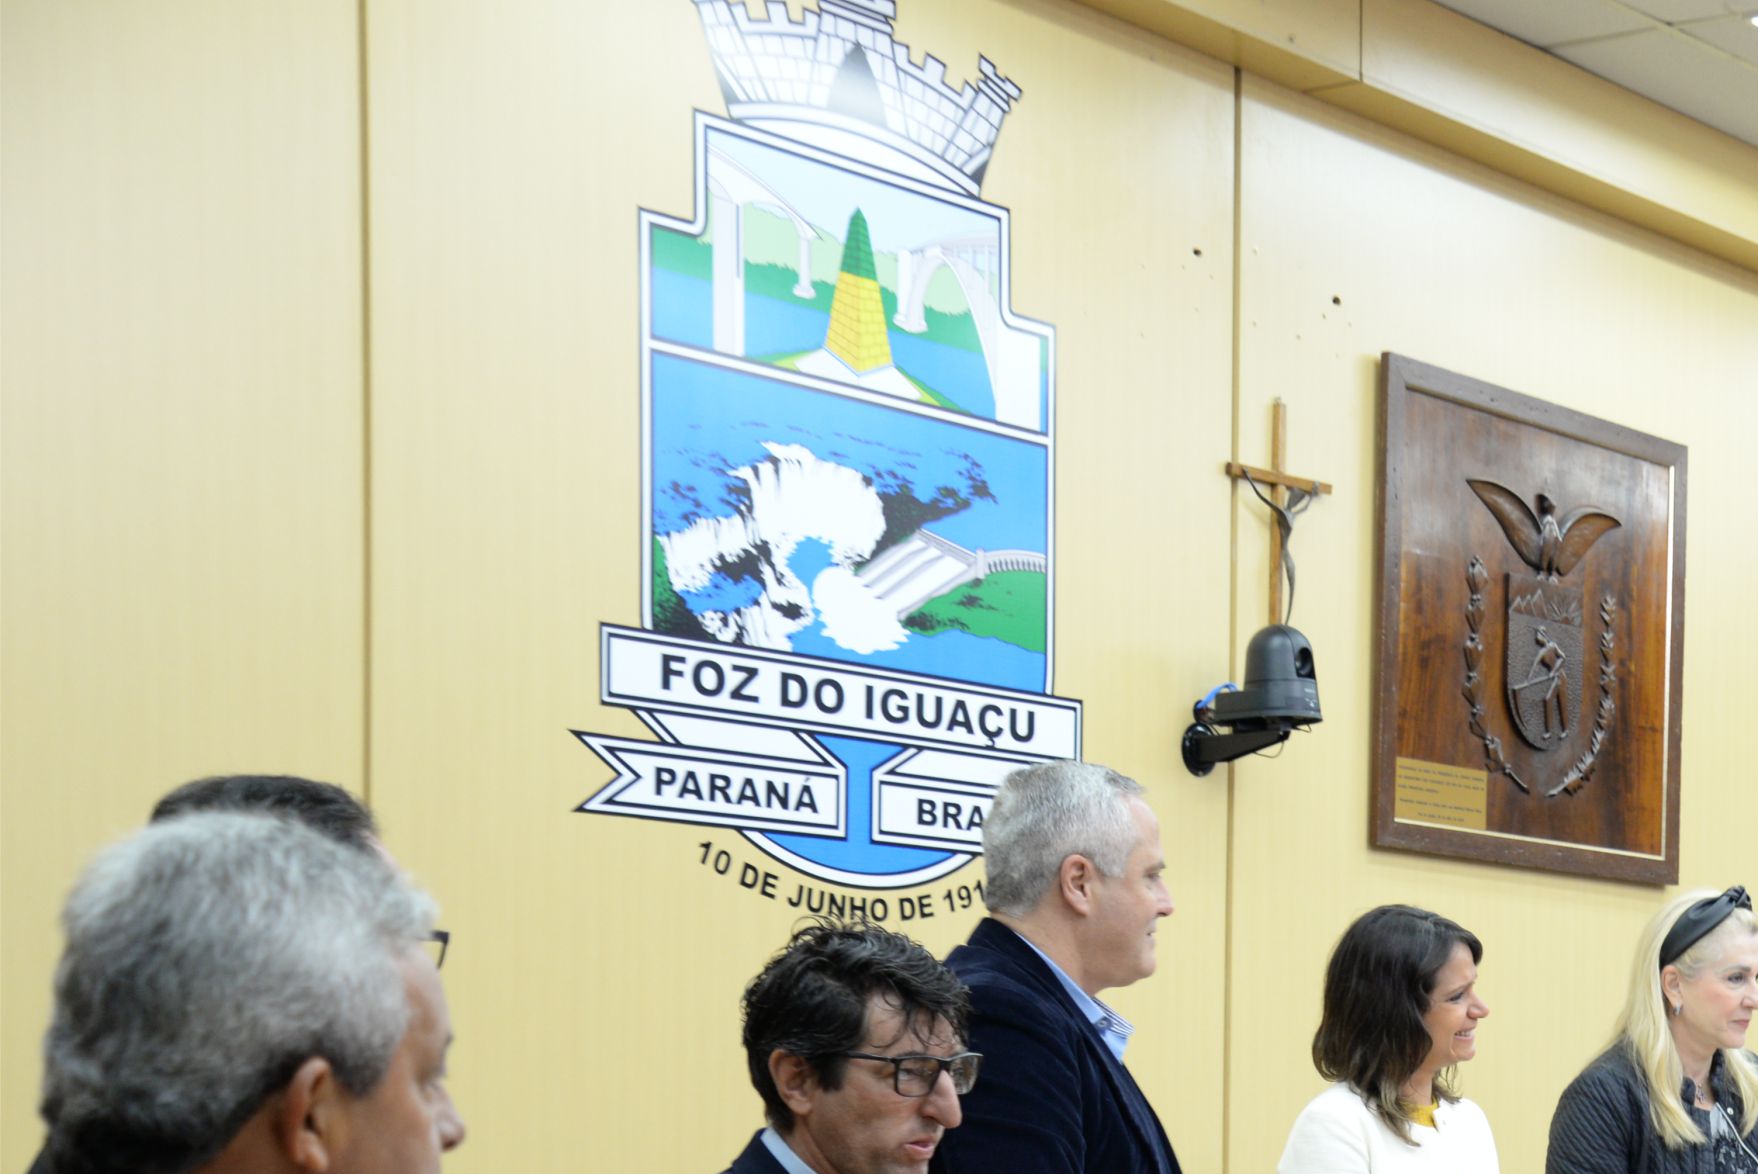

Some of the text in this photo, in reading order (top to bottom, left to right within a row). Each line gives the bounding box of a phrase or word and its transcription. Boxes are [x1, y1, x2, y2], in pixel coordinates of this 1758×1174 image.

[661, 653, 1035, 748] FOZ DO IGUAÇU
[654, 766, 819, 814] PARANÁ
[916, 798, 984, 832] BRA
[698, 840, 985, 922] 10 DE JUNHO DE 191
